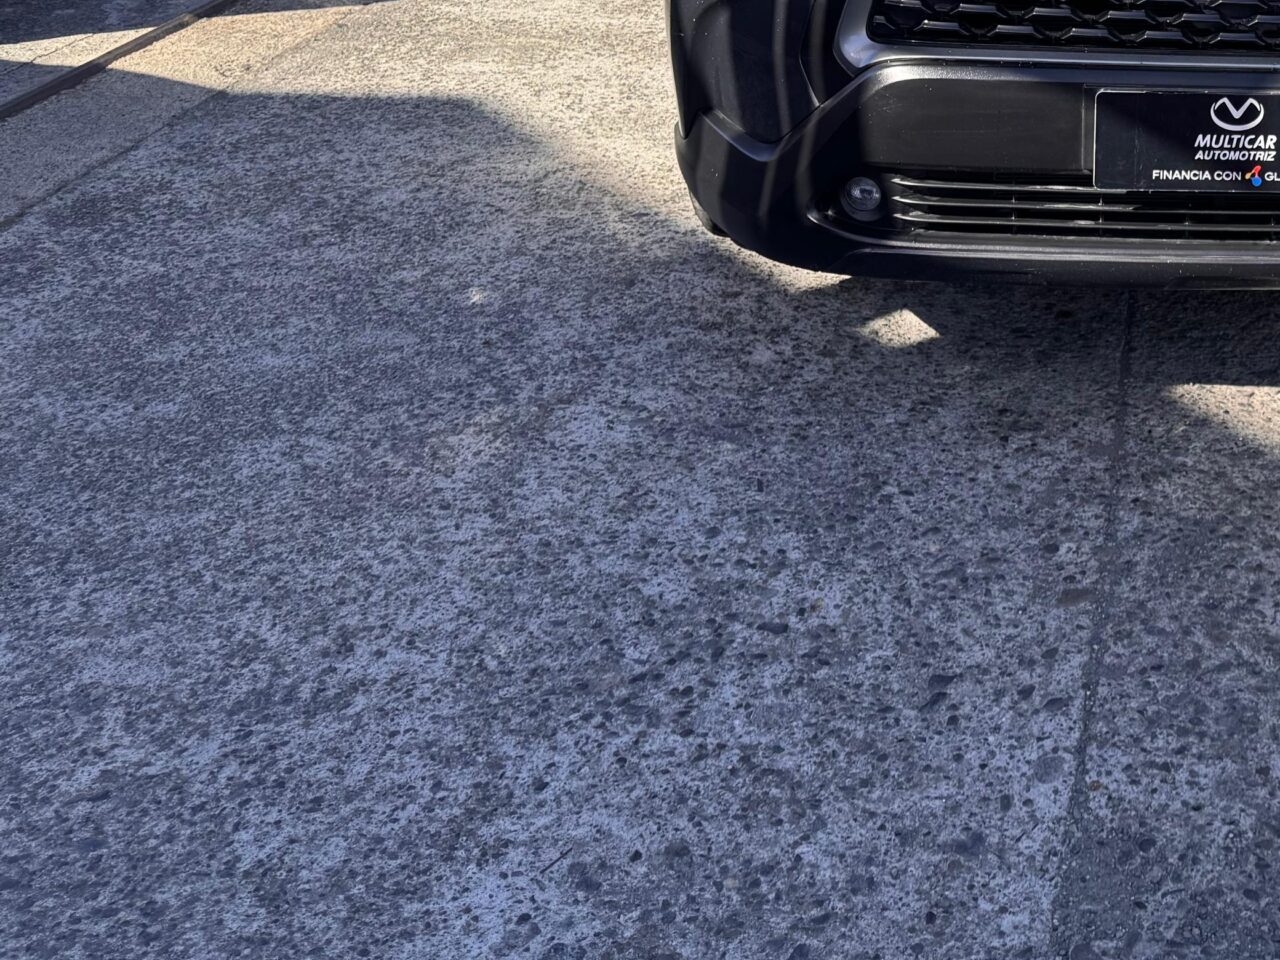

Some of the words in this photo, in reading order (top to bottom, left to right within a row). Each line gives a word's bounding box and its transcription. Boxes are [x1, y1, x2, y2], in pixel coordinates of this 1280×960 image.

[1194, 134, 1277, 150] MULTICAR
[1194, 150, 1277, 161] AUTOMOTRIZ
[1152, 169, 1211, 181] FINANCIA
[1213, 170, 1241, 181] CON
